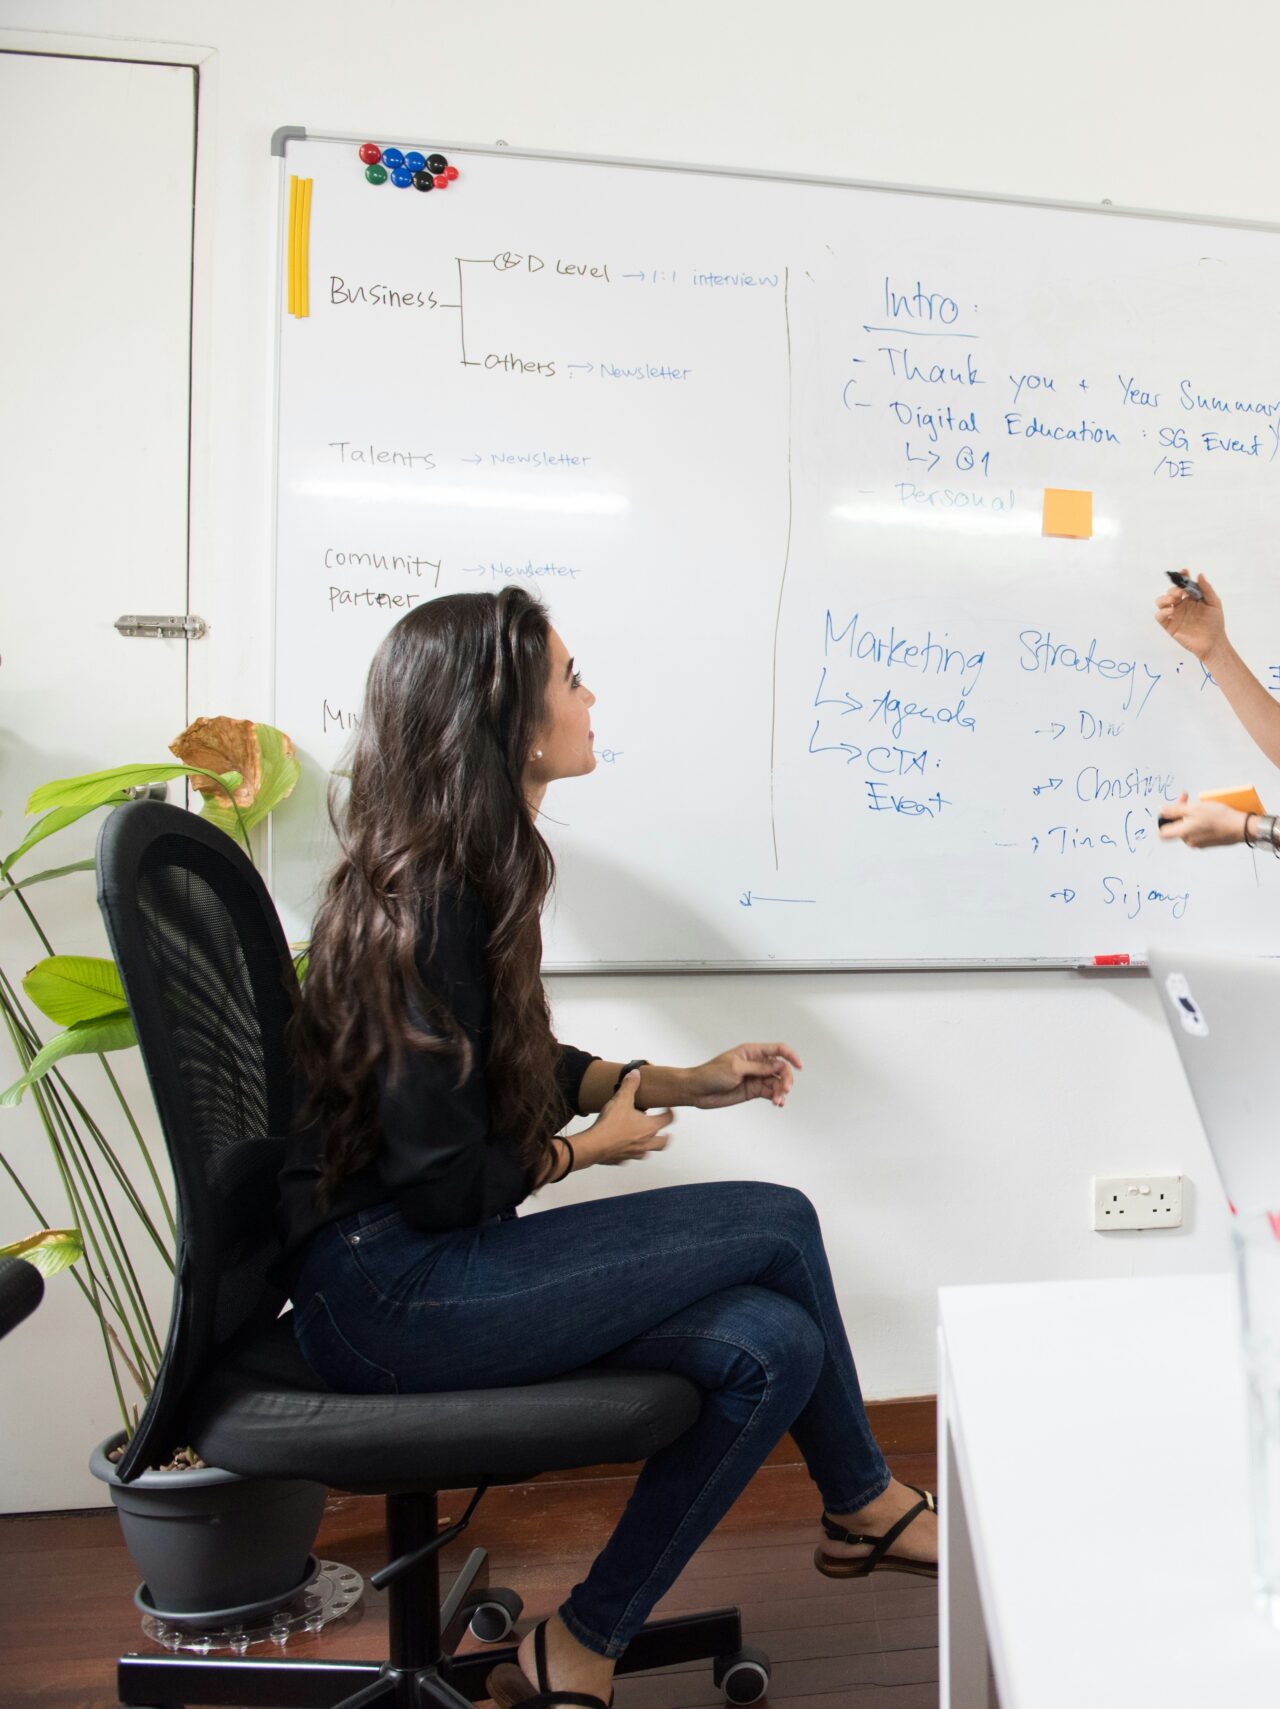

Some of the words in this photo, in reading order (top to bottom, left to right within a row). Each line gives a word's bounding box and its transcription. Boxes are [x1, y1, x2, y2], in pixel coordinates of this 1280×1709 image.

[556, 259, 610, 283] Level
[693, 268, 779, 287] interview
[329, 276, 439, 308] Business
[484, 353, 557, 377] Others
[600, 362, 692, 381] Newsletter
[878, 346, 986, 386] Thank
[1009, 373, 1057, 404] you
[1117, 374, 1161, 408] Year
[889, 401, 980, 442] Digital
[328, 442, 437, 471] Talents
[490, 449, 593, 467] Newsletter
[824, 608, 986, 698] Marketing
